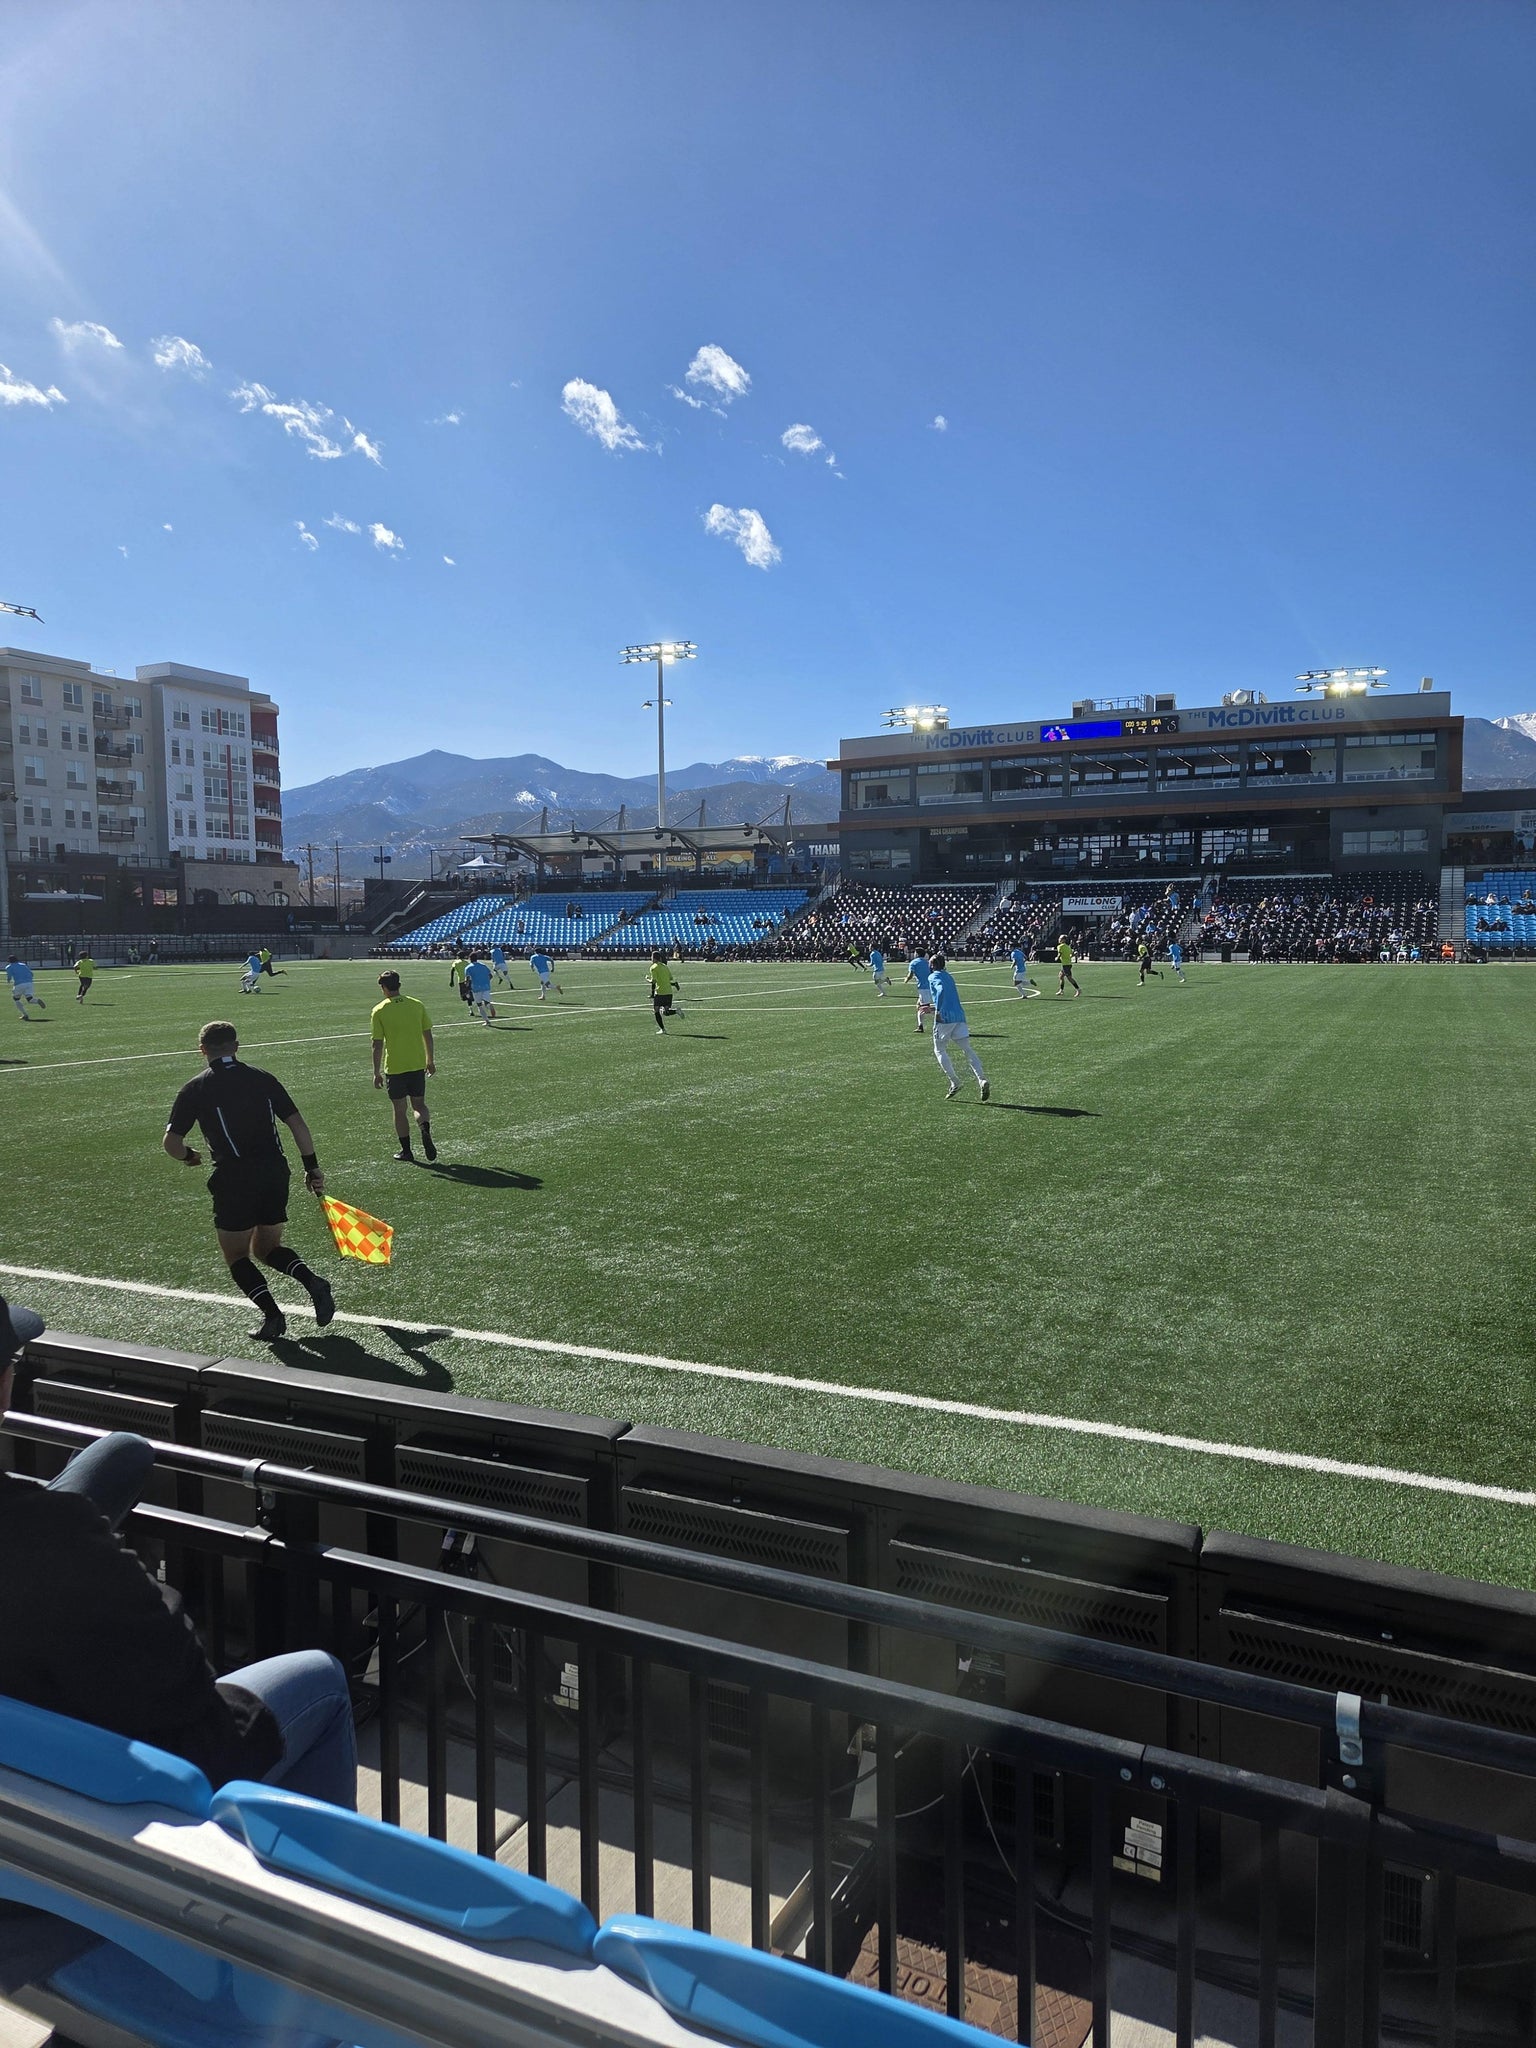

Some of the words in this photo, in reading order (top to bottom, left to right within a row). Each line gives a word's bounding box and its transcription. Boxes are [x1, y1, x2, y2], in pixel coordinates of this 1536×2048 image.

[1188, 711, 1207, 719] THE
[1208, 706, 1296, 728] McDivitt
[1298, 708, 1345, 721] CLUB
[910, 735, 925, 743] THE
[926, 729, 994, 750] McDivitt
[997, 730, 1034, 743] CLUB
[1091, 897, 1116, 906] LONG
